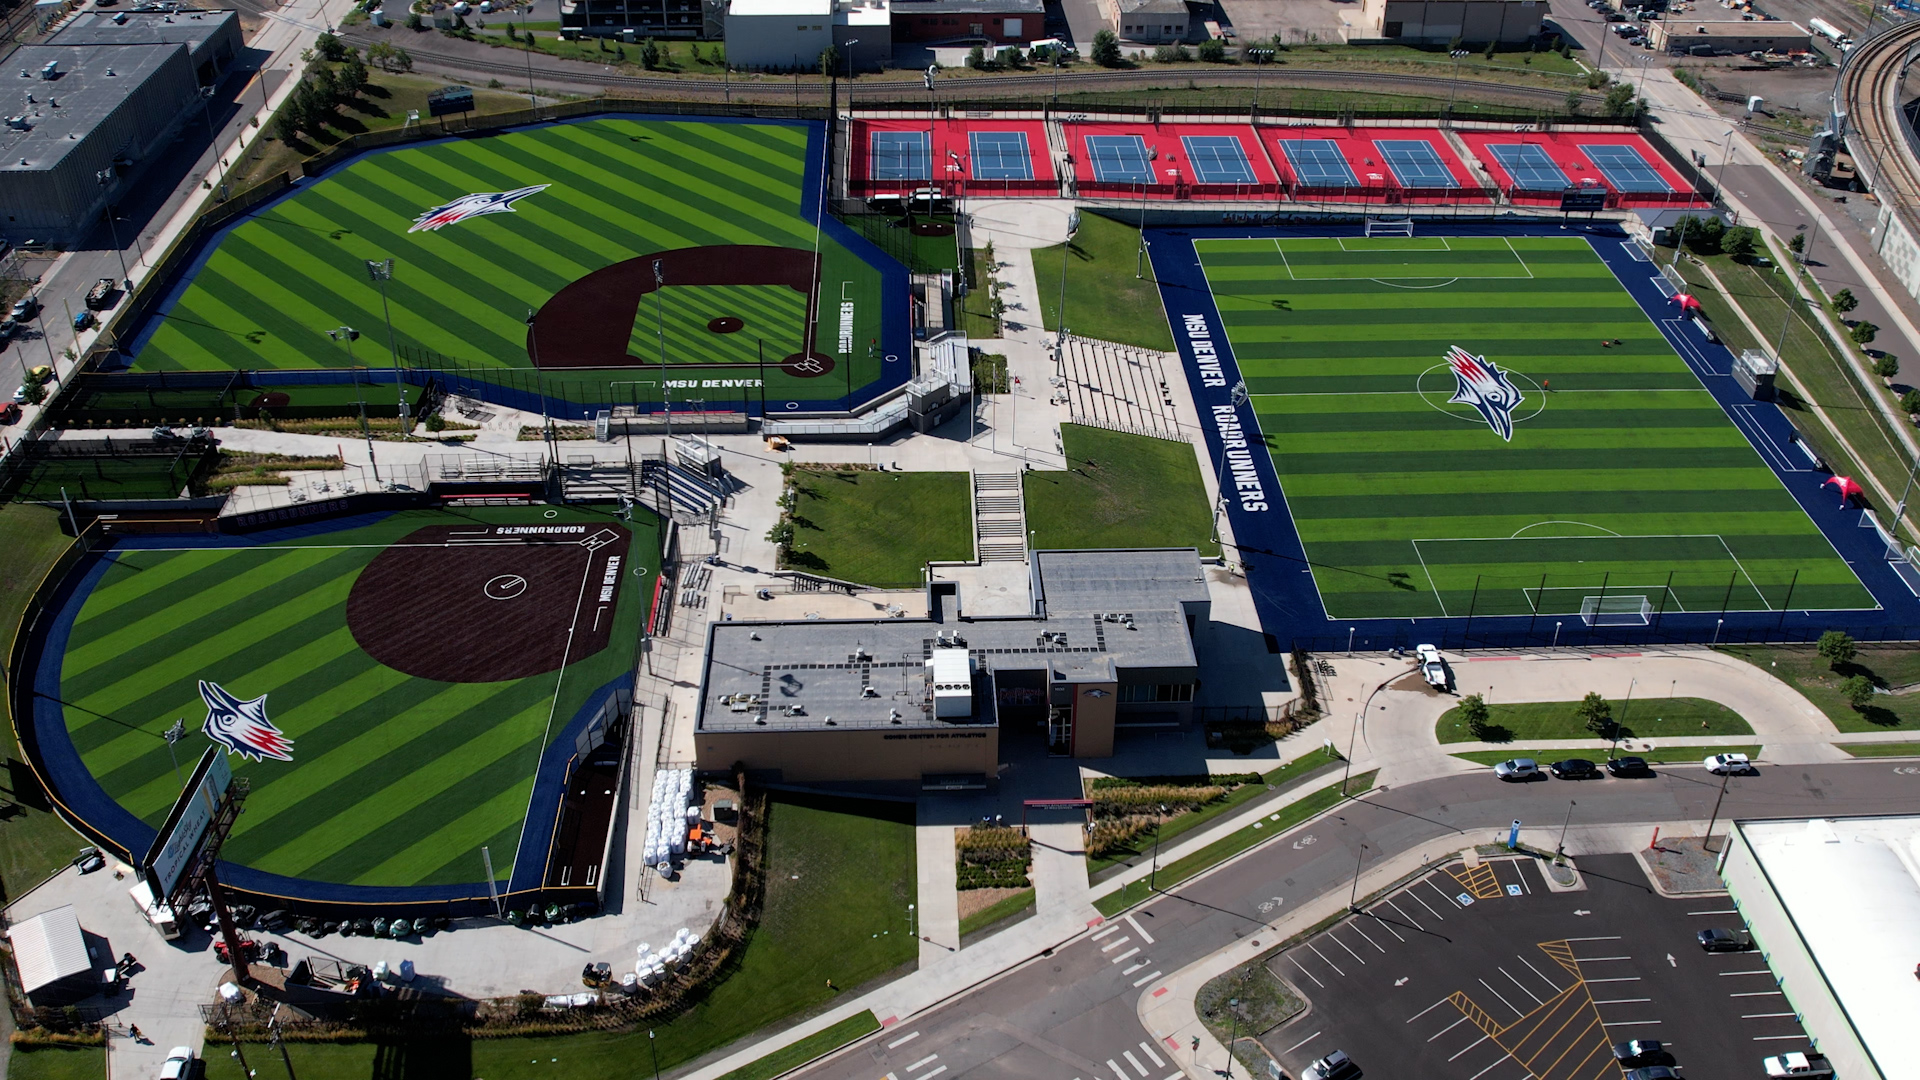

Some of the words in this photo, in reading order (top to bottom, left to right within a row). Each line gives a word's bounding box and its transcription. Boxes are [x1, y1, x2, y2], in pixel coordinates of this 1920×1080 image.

[838, 302, 854, 353] ROADRUNNERS
[1182, 314, 1210, 338] MSU
[1191, 340, 1226, 388] DENVER
[662, 379, 698, 388] MSU
[701, 379, 765, 388] DENVER
[1211, 404, 1269, 512] ROADRUNNERS
[236, 499, 349, 527] ROADRUNNERS
[496, 526, 585, 535] ROADRUNNERS
[603, 555, 621, 585] DENVER
[599, 585, 614, 602] MSU
[164, 842, 190, 884] TROPICAL
[188, 809, 206, 840] WHEAT
